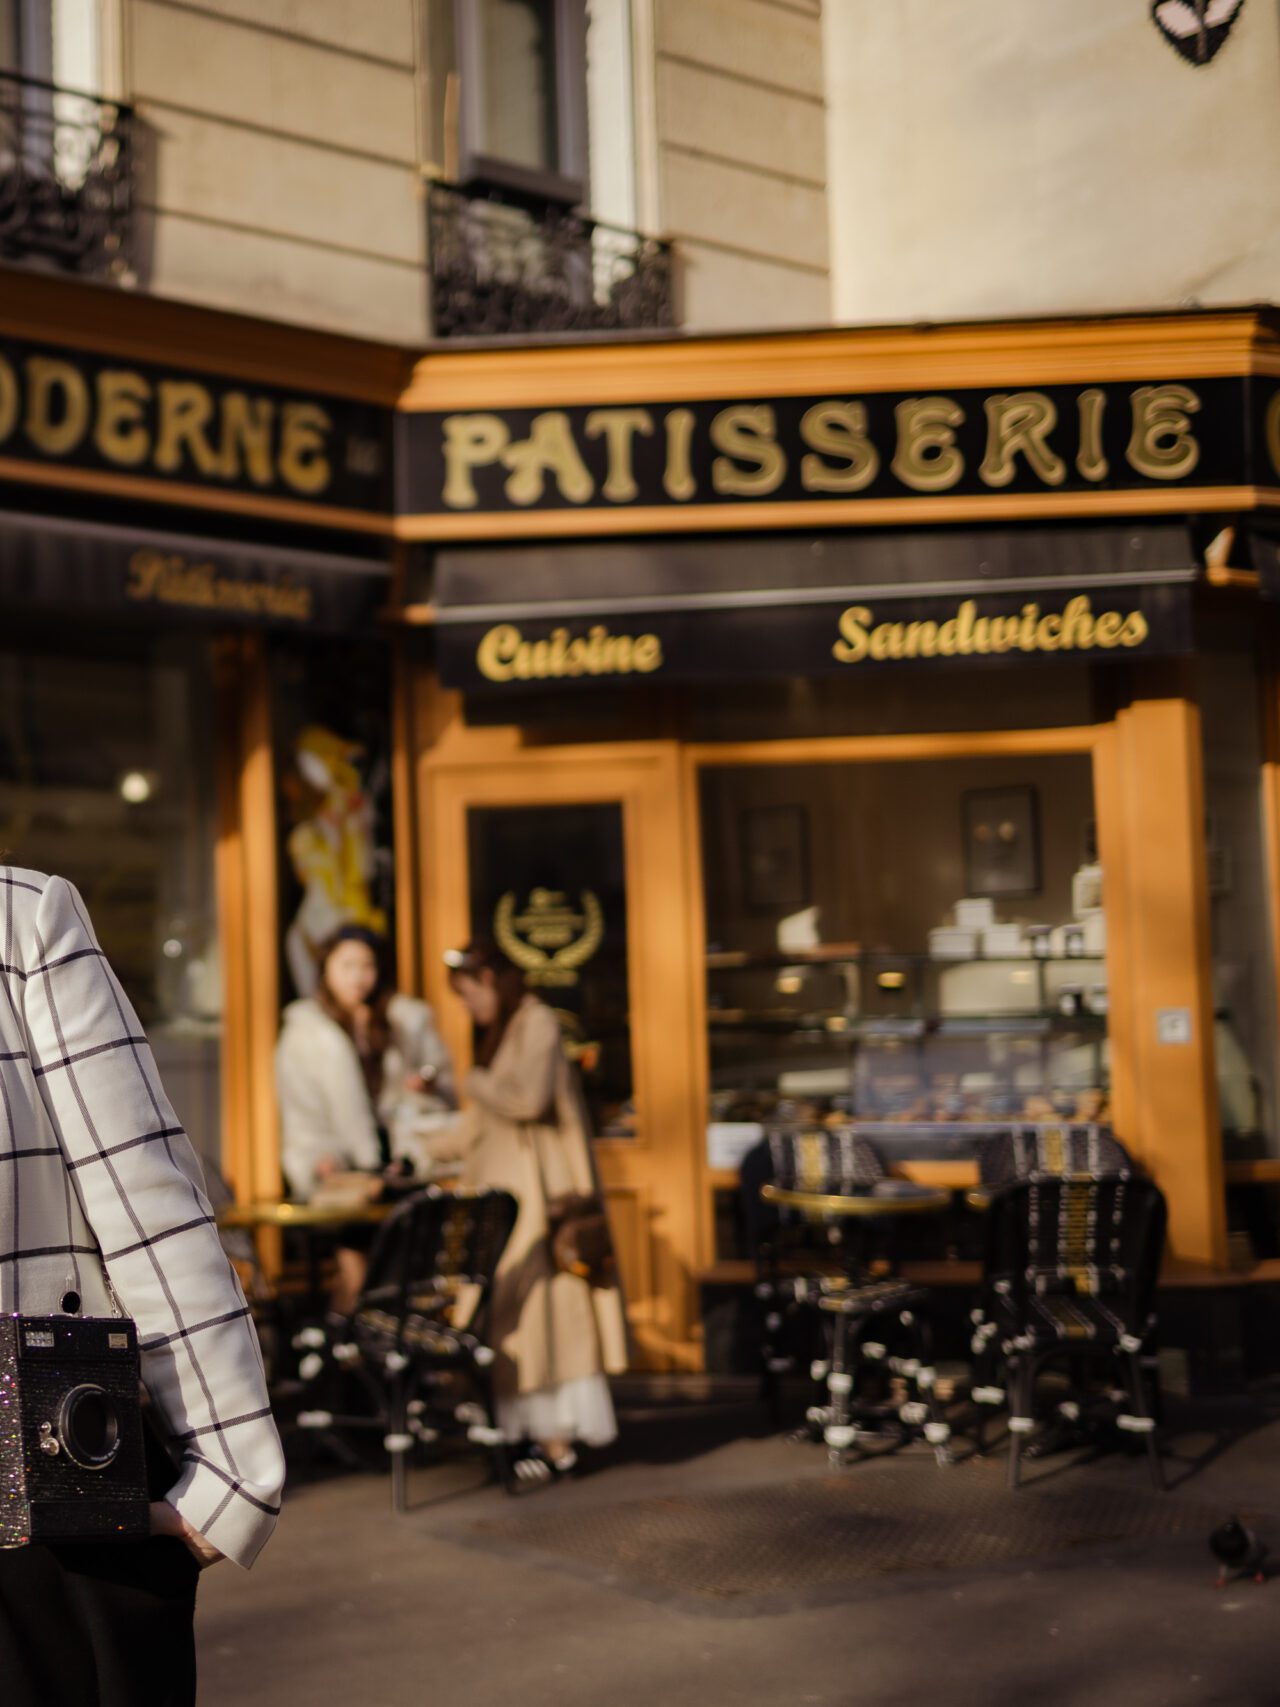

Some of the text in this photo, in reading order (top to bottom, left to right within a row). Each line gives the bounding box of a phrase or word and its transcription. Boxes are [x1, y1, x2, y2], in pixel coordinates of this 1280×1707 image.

[441, 385, 1202, 509] PATISSERIE
[477, 623, 663, 682] Cuisine
[833, 594, 1149, 664] Sandwiches
